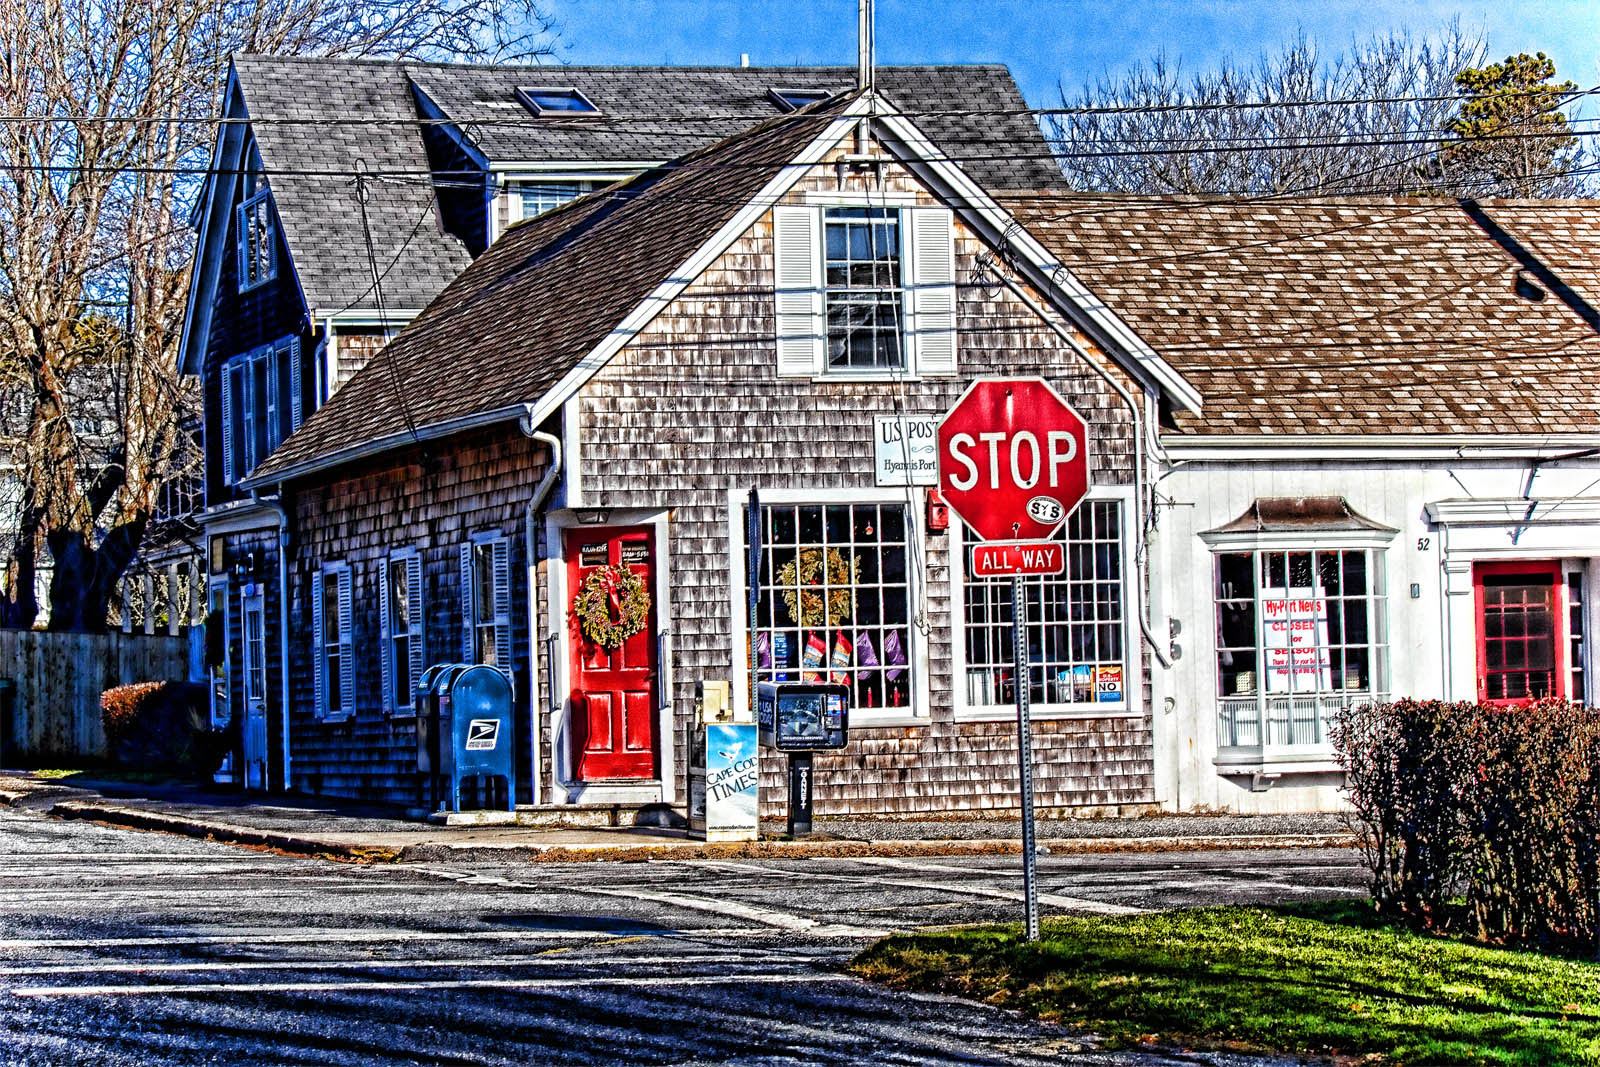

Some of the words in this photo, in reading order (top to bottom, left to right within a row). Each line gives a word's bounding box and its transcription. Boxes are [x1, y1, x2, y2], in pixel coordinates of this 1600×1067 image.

[918, 459, 937, 470] Port
[949, 430, 1077, 491] STOP
[1417, 537, 1430, 551] 52
[982, 551, 1013, 570] ALL
[1021, 548, 1055, 569] WAY
[1098, 682, 1116, 691] NO
[706, 767, 733, 785] CAPE
[734, 757, 758, 772] COD
[706, 771, 758, 802] TIMES
